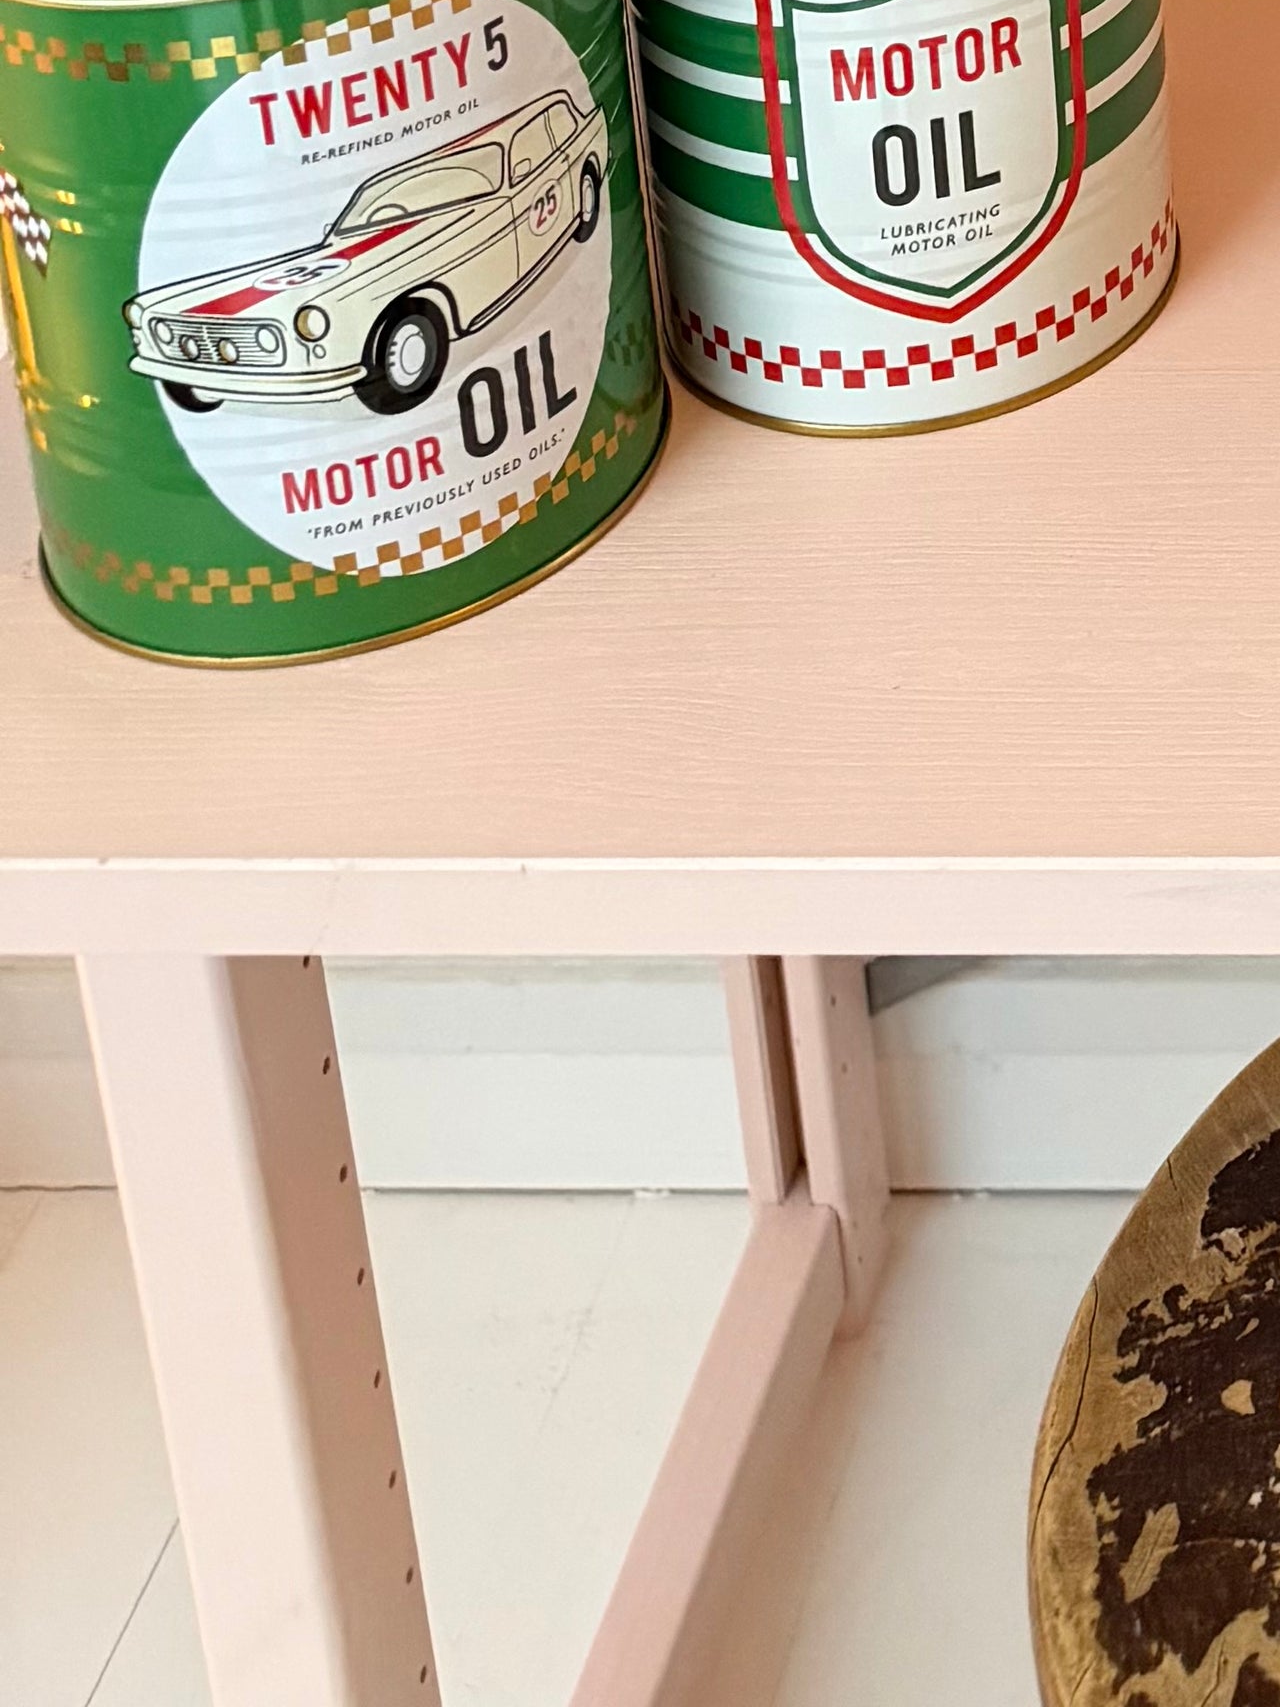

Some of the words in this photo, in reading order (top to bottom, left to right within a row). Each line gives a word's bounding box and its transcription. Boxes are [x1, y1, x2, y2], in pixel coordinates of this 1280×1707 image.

[249, 32, 472, 146] TWENTY
[483, 15, 509, 72] 5
[830, 16, 1023, 103] MOTOR
[301, 132, 393, 165] RE-REFINED
[401, 110, 453, 139] MOTOR
[457, 98, 480, 116] OIL
[871, 109, 1001, 208] OIL
[533, 184, 558, 229] 25
[880, 203, 1001, 240] LUBRICATING
[890, 234, 957, 257] MOTOR
[965, 224, 994, 242] OIL
[262, 264, 341, 286] 25
[281, 436, 445, 515] MOTOR
[457, 329, 578, 458] OIL
[372, 480, 475, 527] PREVIOUSLY
[482, 457, 522, 486] USED
